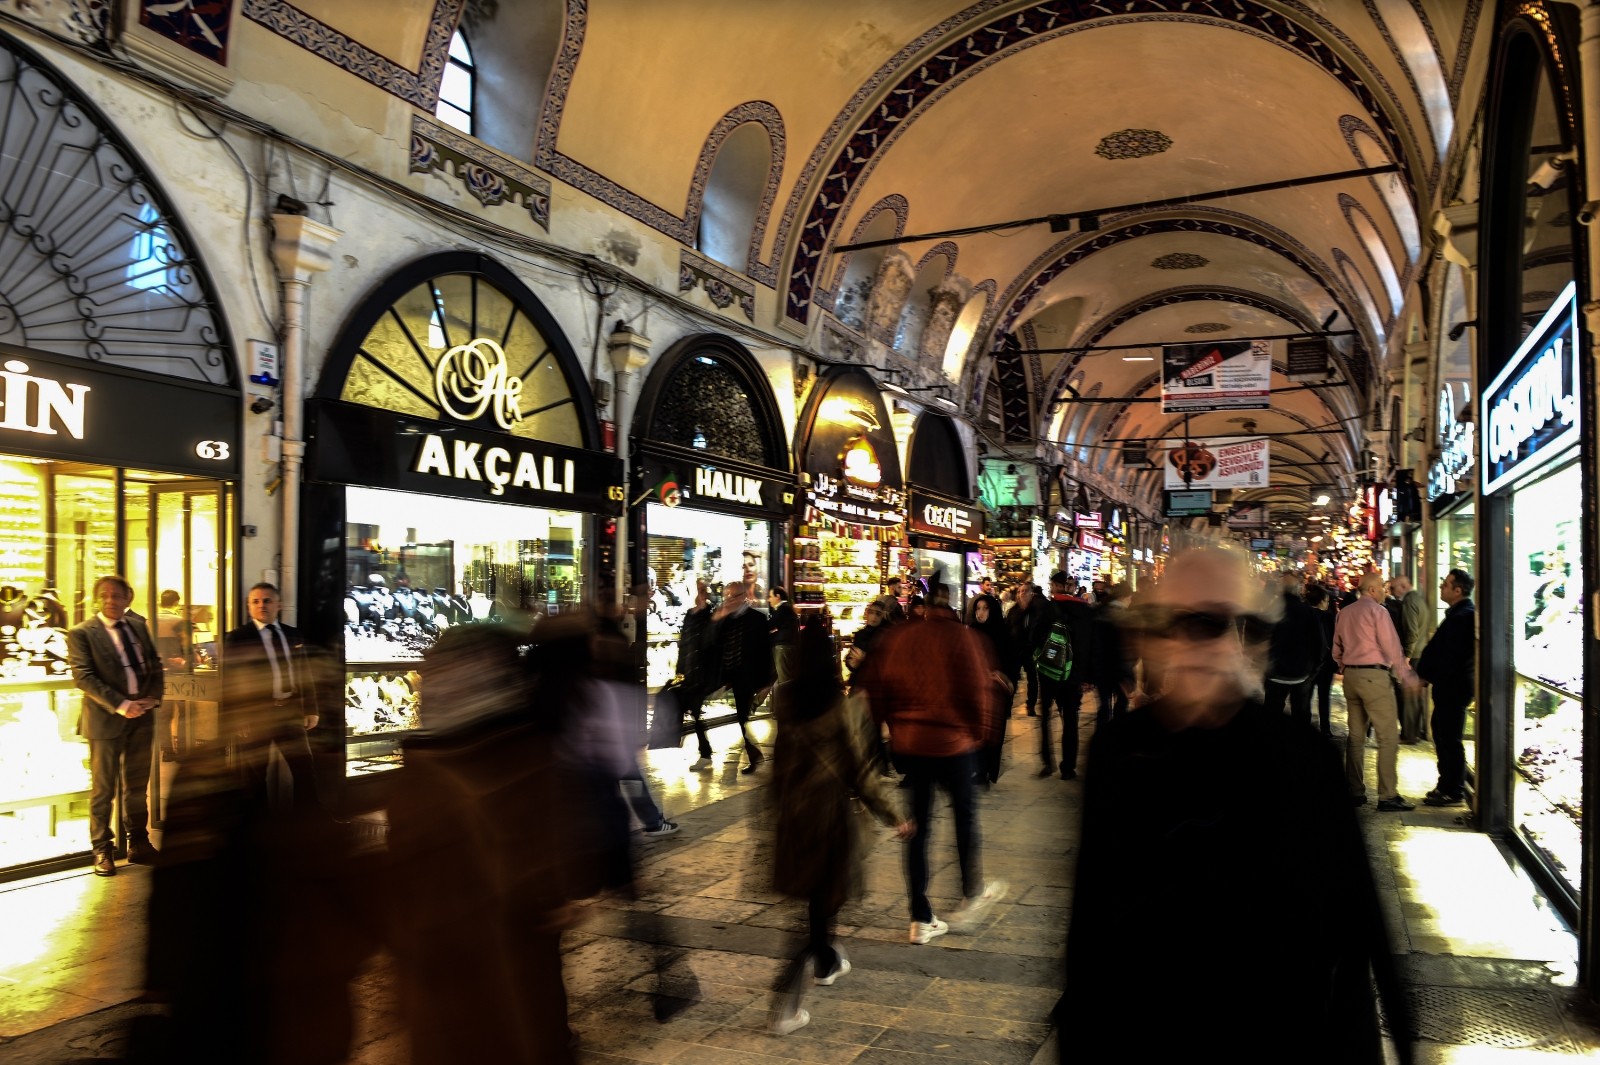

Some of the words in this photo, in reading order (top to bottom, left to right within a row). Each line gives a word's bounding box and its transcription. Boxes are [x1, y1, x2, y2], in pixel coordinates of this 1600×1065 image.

[0, 359, 91, 440] İN
[195, 440, 230, 461] 63
[416, 434, 575, 496] AKÇALI
[608, 486, 624, 501] 65
[695, 467, 764, 506] HALUK
